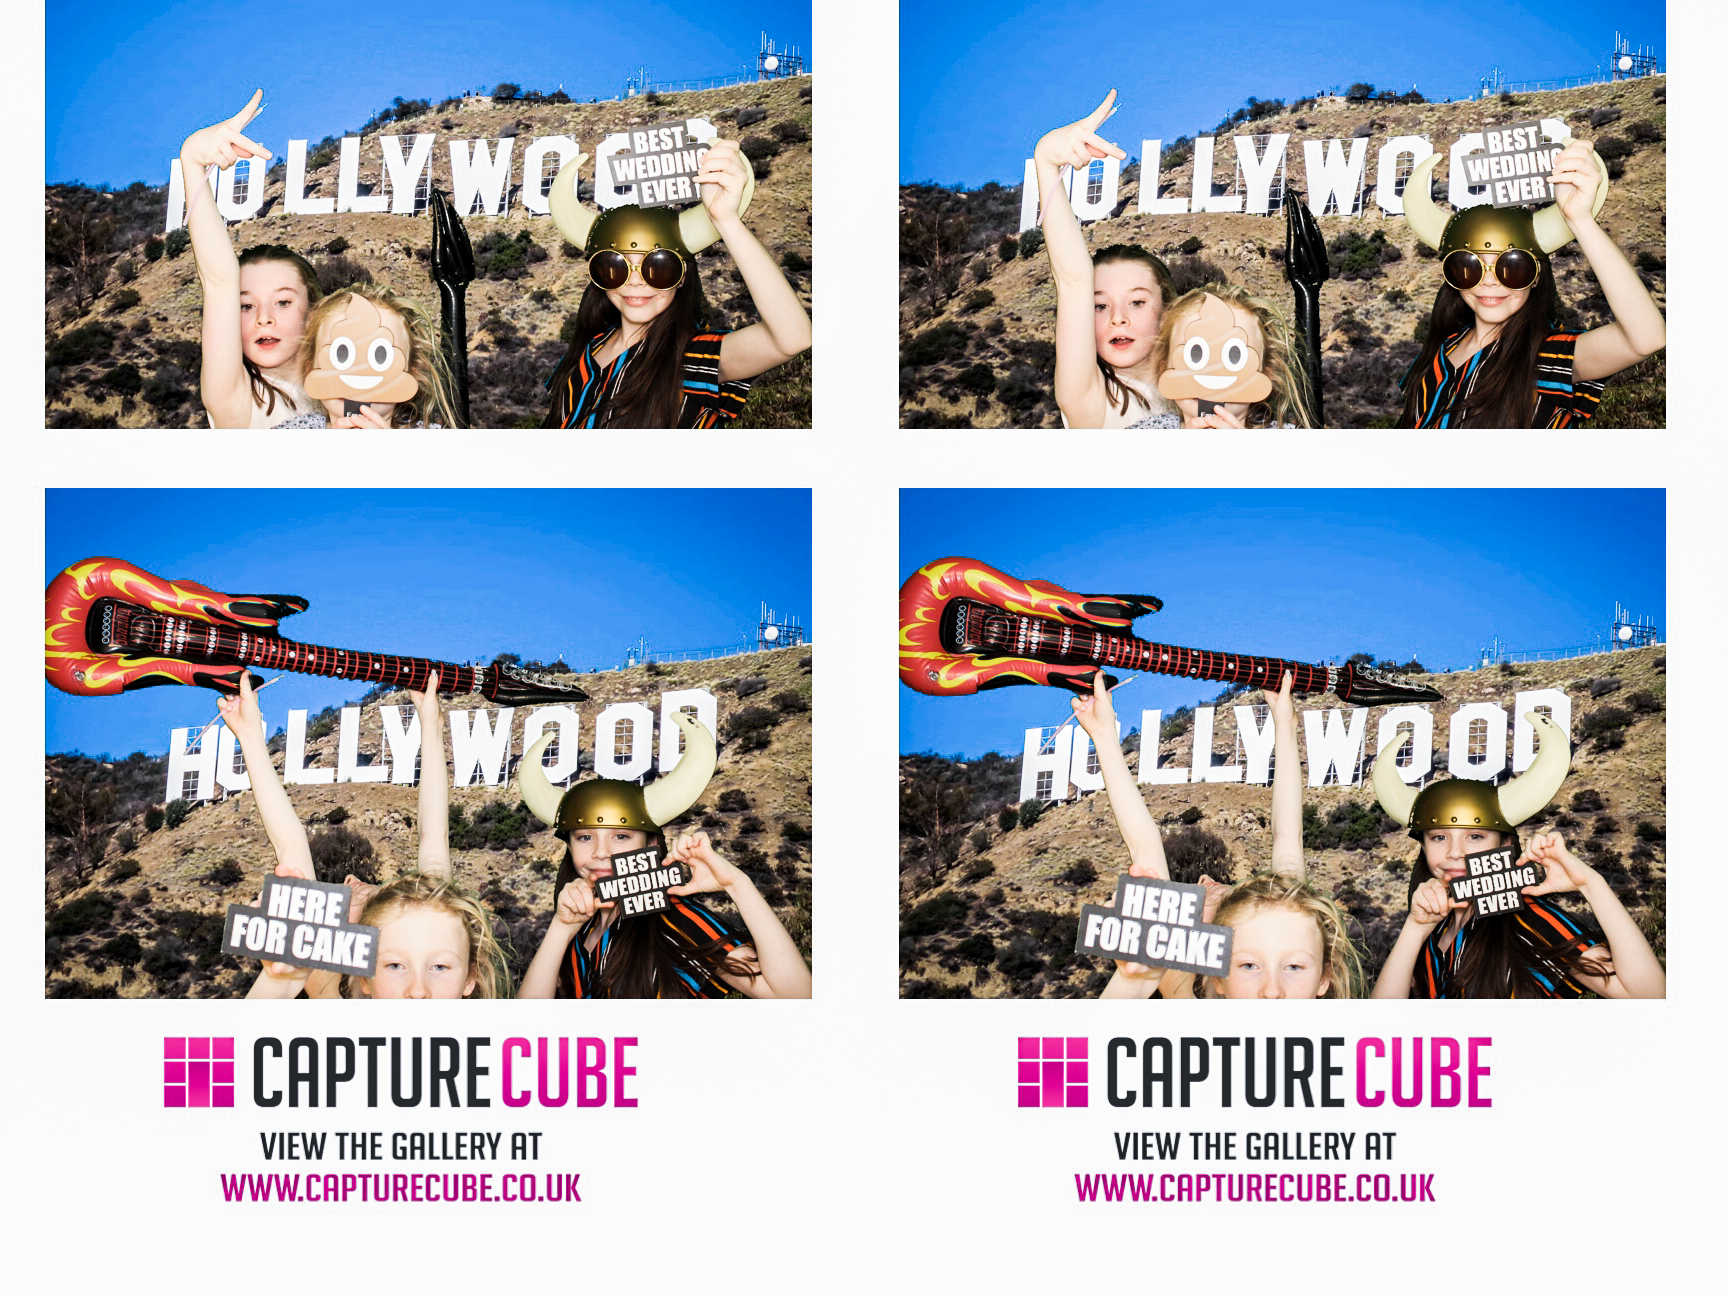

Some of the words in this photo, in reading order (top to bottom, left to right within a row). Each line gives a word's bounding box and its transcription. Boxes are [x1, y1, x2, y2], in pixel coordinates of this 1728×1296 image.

[633, 126, 684, 154] BEST
[1487, 126, 1538, 154] BEST
[641, 176, 692, 204] EVER
[1495, 176, 1546, 204] EVER
[615, 851, 657, 876] BEST
[1469, 851, 1511, 876] BEST
[599, 866, 682, 899] WEDDING
[1453, 866, 1536, 899] WEDDING
[267, 883, 344, 927] HERE
[623, 891, 666, 915] EVER
[1121, 883, 1198, 927] HERE
[1477, 891, 1520, 915] EVER
[230, 914, 288, 955] FOR
[292, 924, 372, 969] CAKE
[1084, 914, 1142, 955] FOR
[1146, 924, 1226, 969] CAKE
